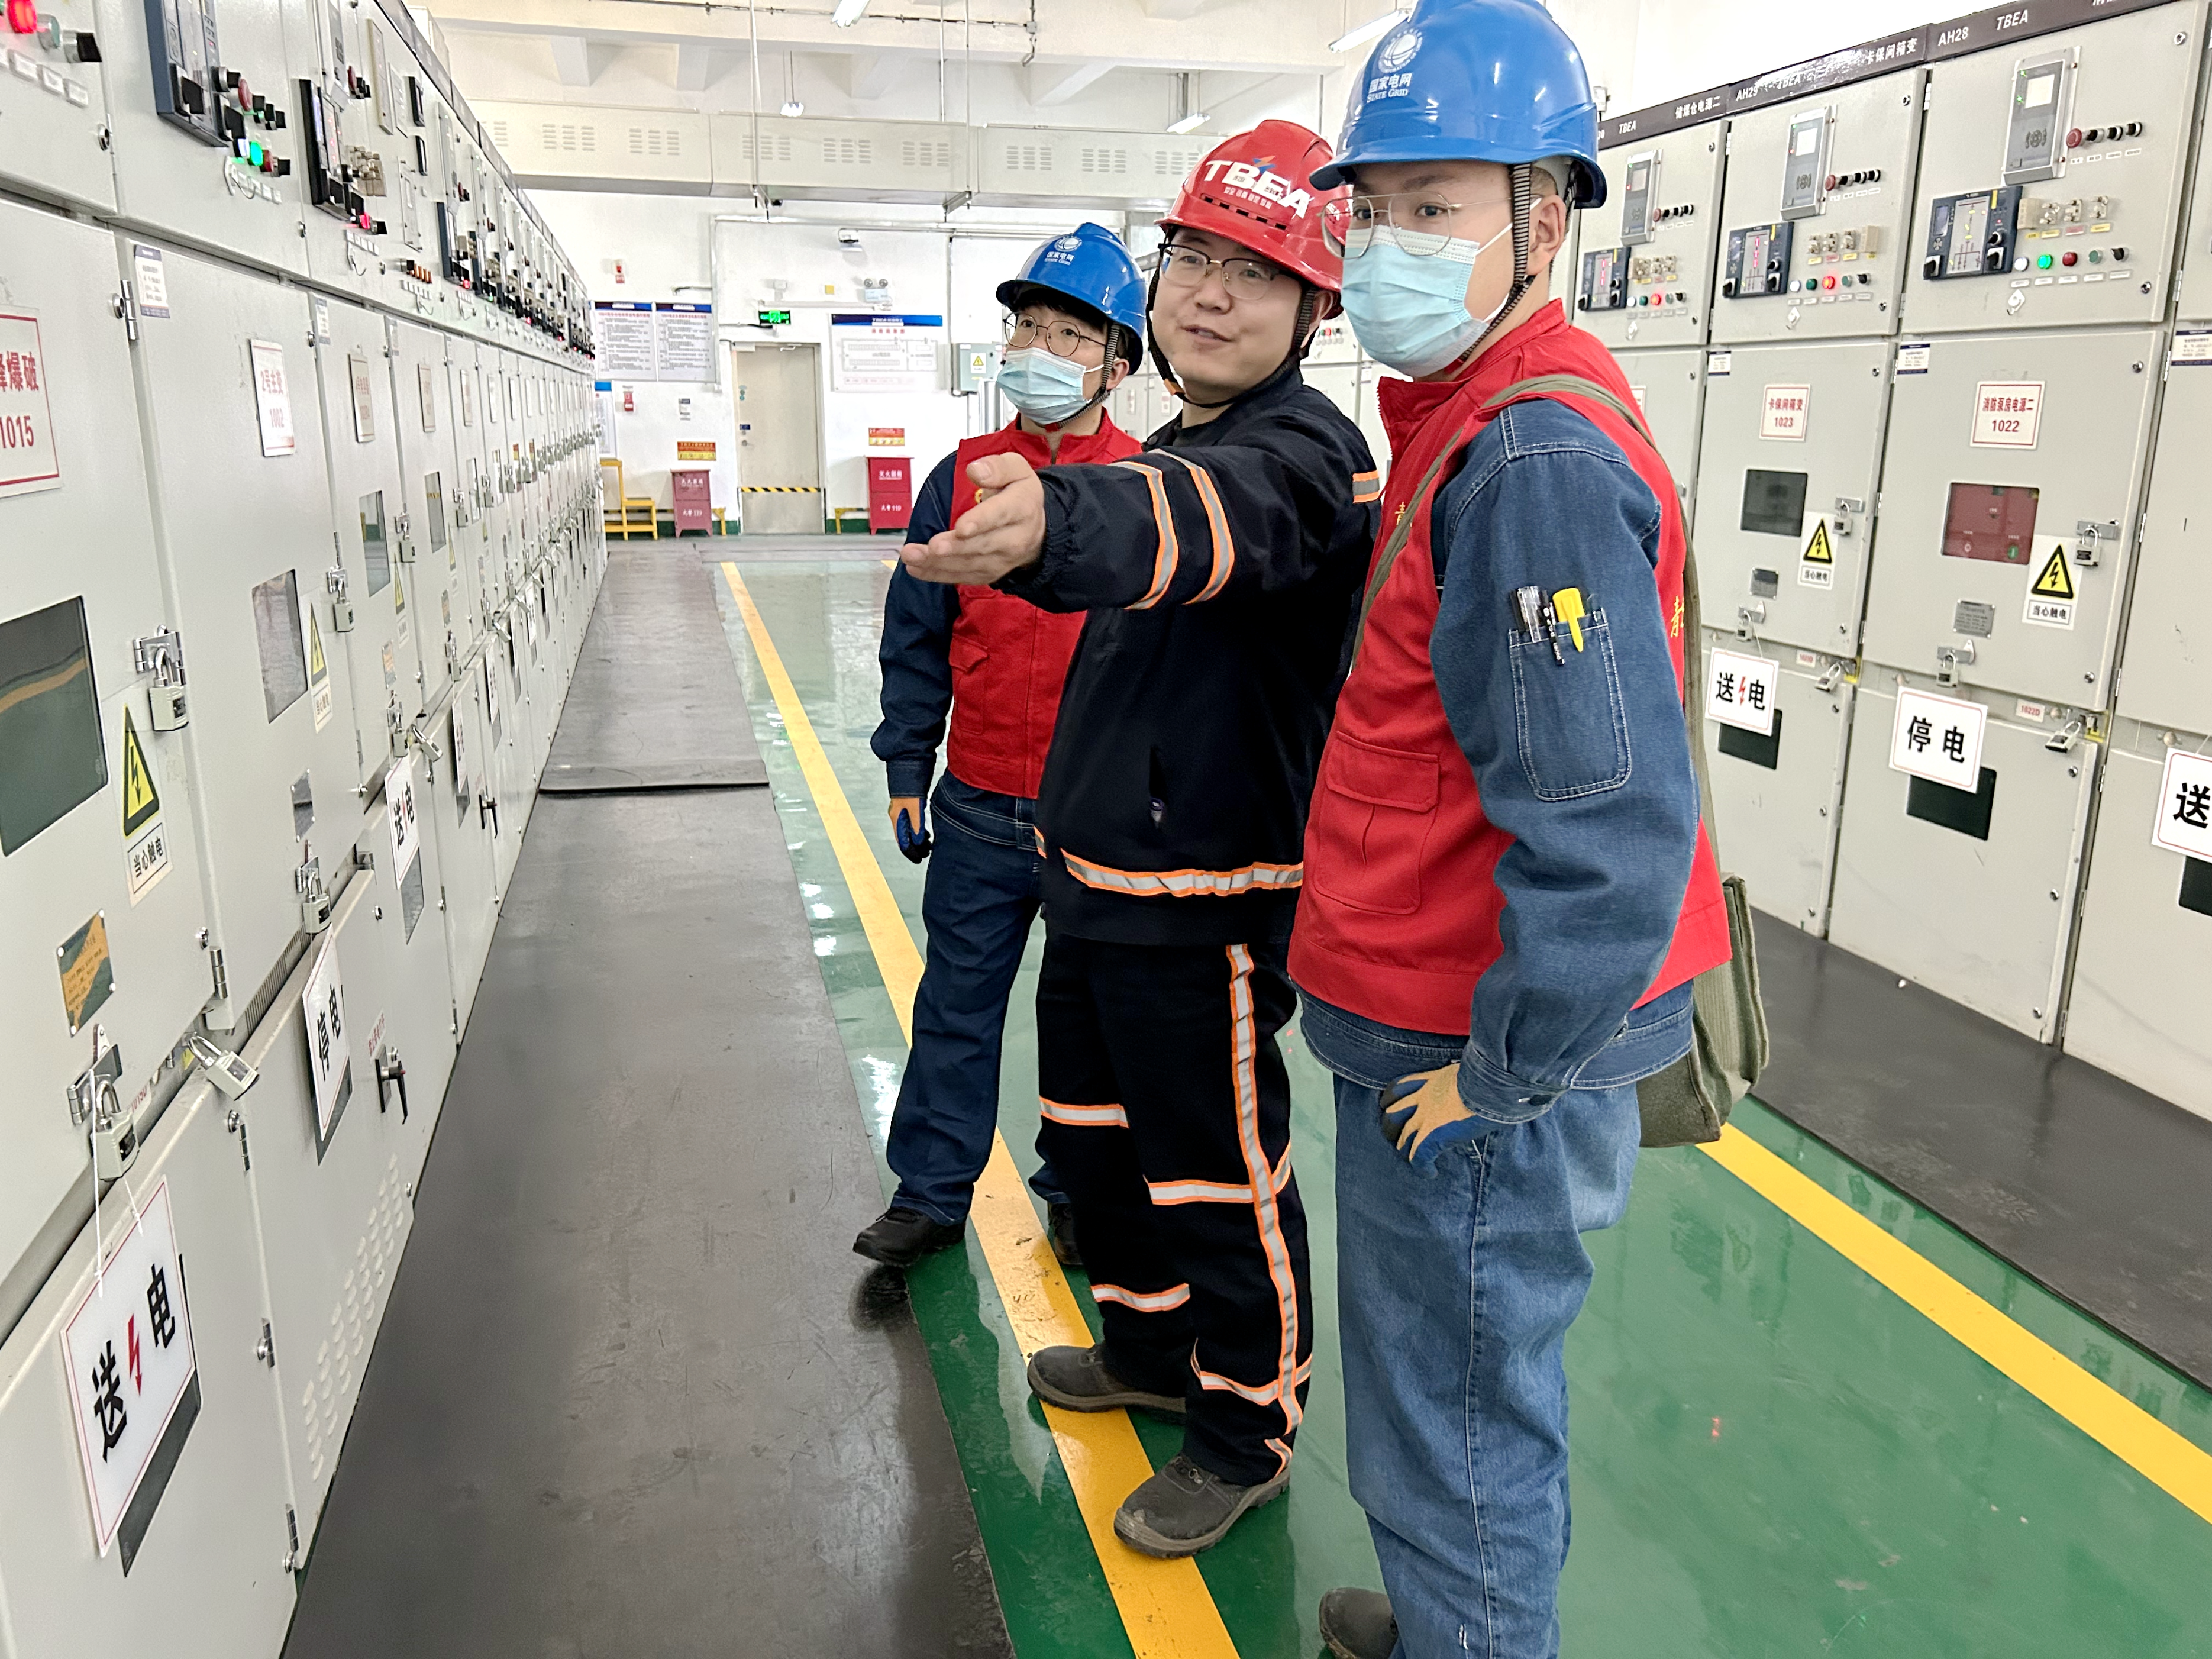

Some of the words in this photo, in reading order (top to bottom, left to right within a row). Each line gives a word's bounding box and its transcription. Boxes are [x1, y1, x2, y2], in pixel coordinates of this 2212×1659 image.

[1937, 27, 1969, 46] AH28
[1997, 9, 2028, 30] TBEA
[1367, 91, 1387, 103] STATE
[1388, 88, 1409, 98] GRID
[1368, 73, 1412, 94] 国家电网
[1736, 86, 1758, 102] AH29
[1619, 120, 1636, 135] TBEA
[1204, 160, 1312, 219] TBEA
[260, 370, 283, 395] 2号主变
[1982, 396, 2034, 412] 消防泵房电源二
[1775, 417, 1794, 428] 1023
[1991, 419, 2020, 432] 1022
[2032, 605, 2067, 620] 当心触电
[1715, 671, 1765, 711] 送电
[1907, 715, 1965, 764] 停电
[2172, 782, 2211, 830] 送
[133, 835, 163, 879] 当心触电
[317, 983, 341, 1082] 停电
[91, 1263, 176, 1464] 送电
